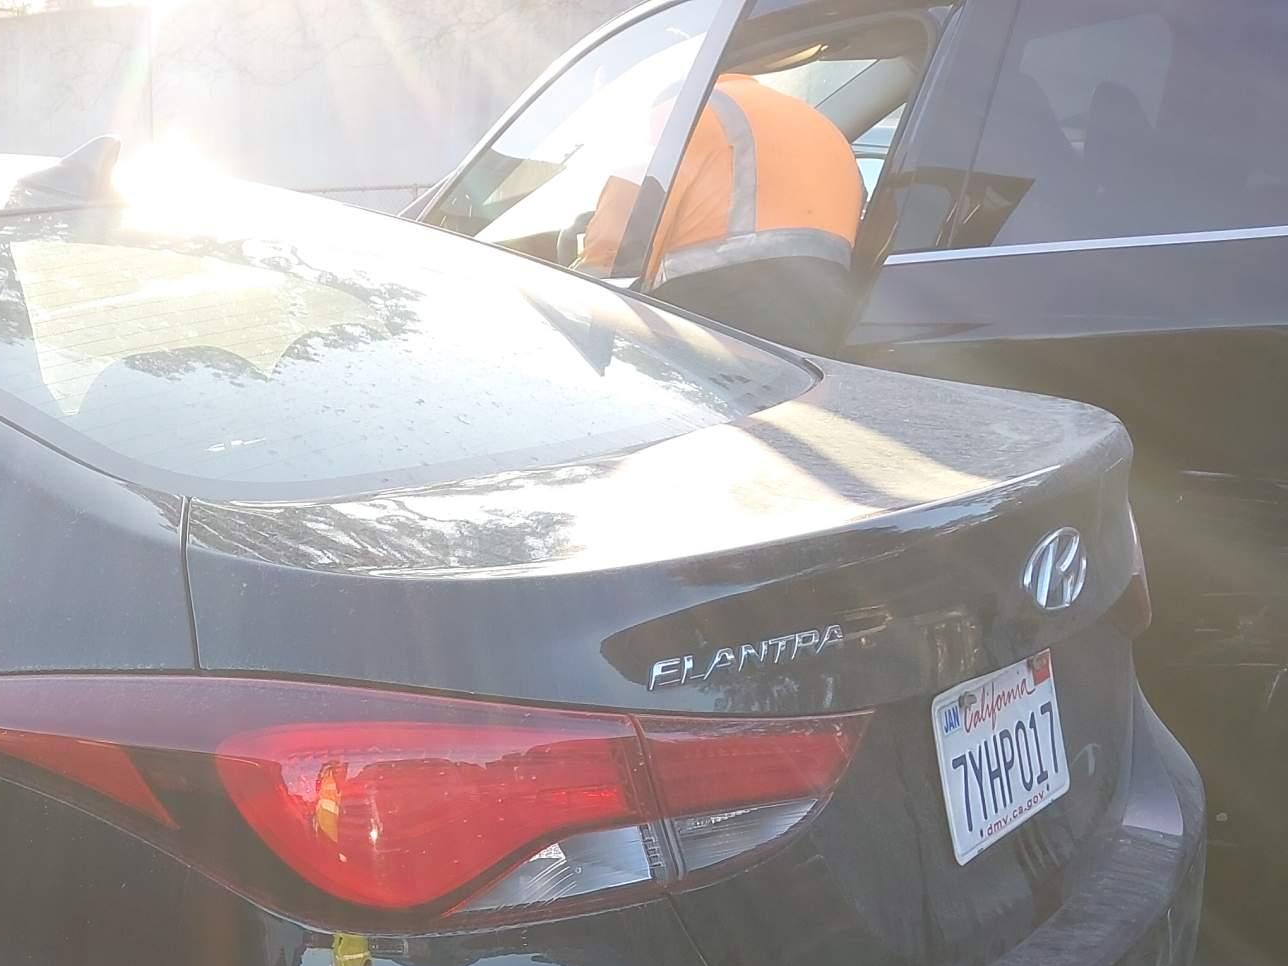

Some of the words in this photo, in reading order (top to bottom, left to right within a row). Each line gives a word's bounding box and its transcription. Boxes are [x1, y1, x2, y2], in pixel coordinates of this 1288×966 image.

[647, 624, 844, 692] ELANTRA
[943, 706, 960, 733] JAN
[964, 678, 1035, 733] California
[952, 701, 1059, 832] 7YHP017
[987, 790, 1045, 837] dmv.ca.gov
